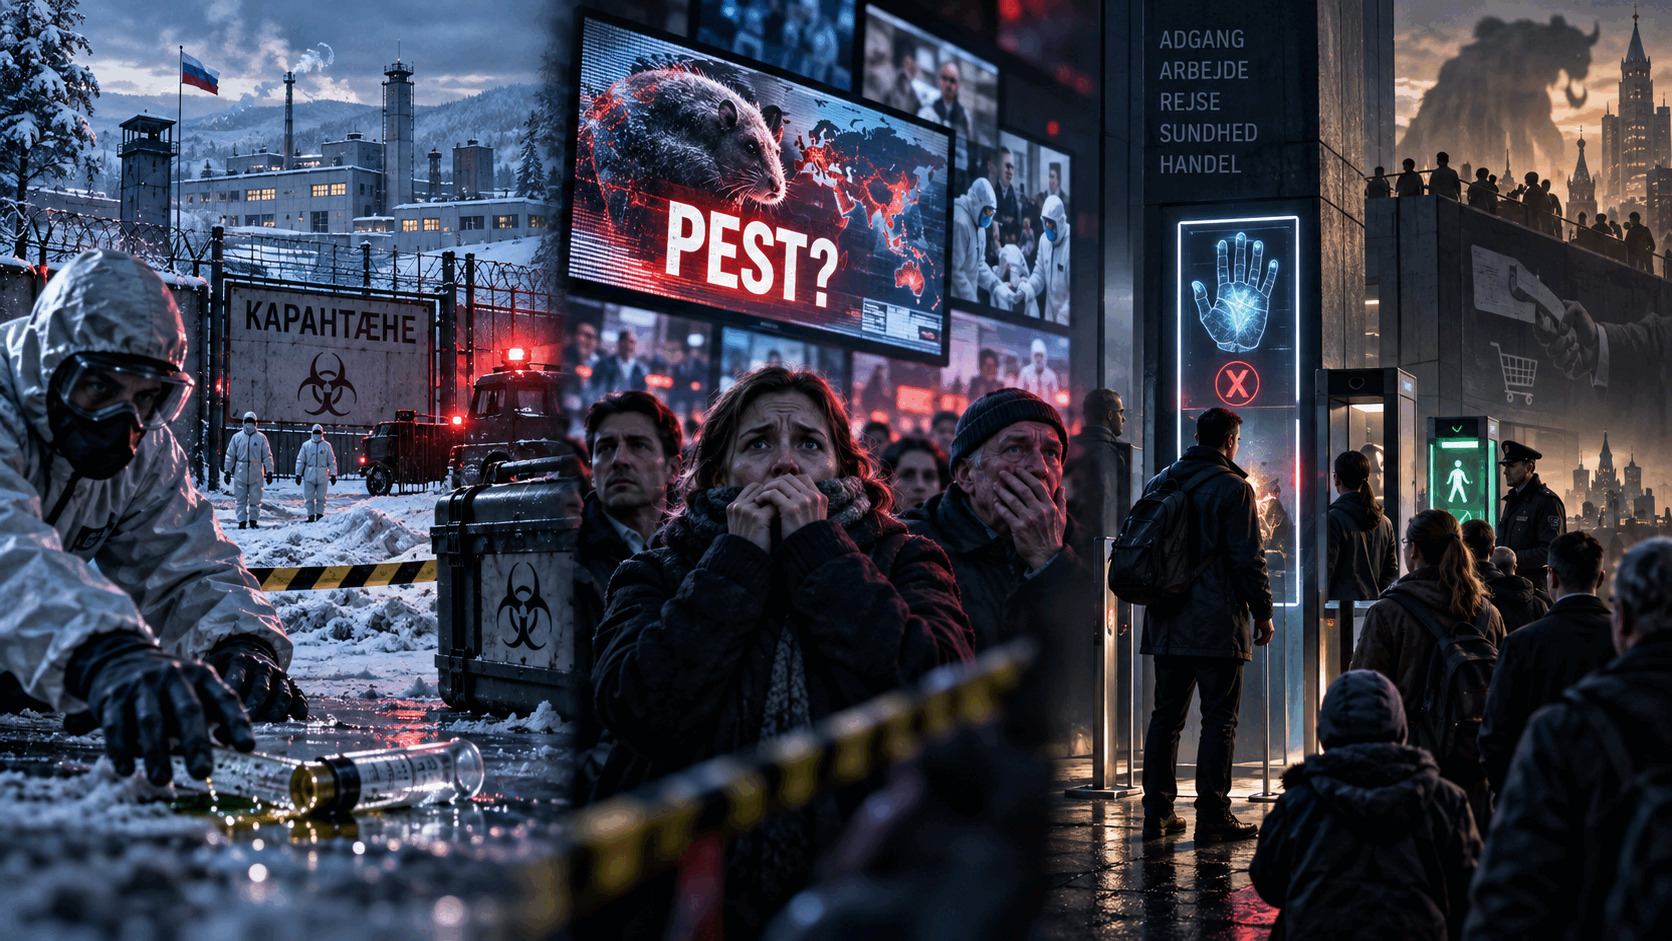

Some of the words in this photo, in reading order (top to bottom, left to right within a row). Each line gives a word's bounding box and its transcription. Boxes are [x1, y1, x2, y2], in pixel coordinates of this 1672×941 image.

[1159, 29, 1244, 49] ADGANG
[1159, 60, 1249, 80] ARBEJDE
[1160, 92, 1221, 112] REJSE
[1159, 123, 1258, 143] SUNDHED
[1160, 154, 1242, 174] HANDEL
[665, 200, 838, 308] PEST?
